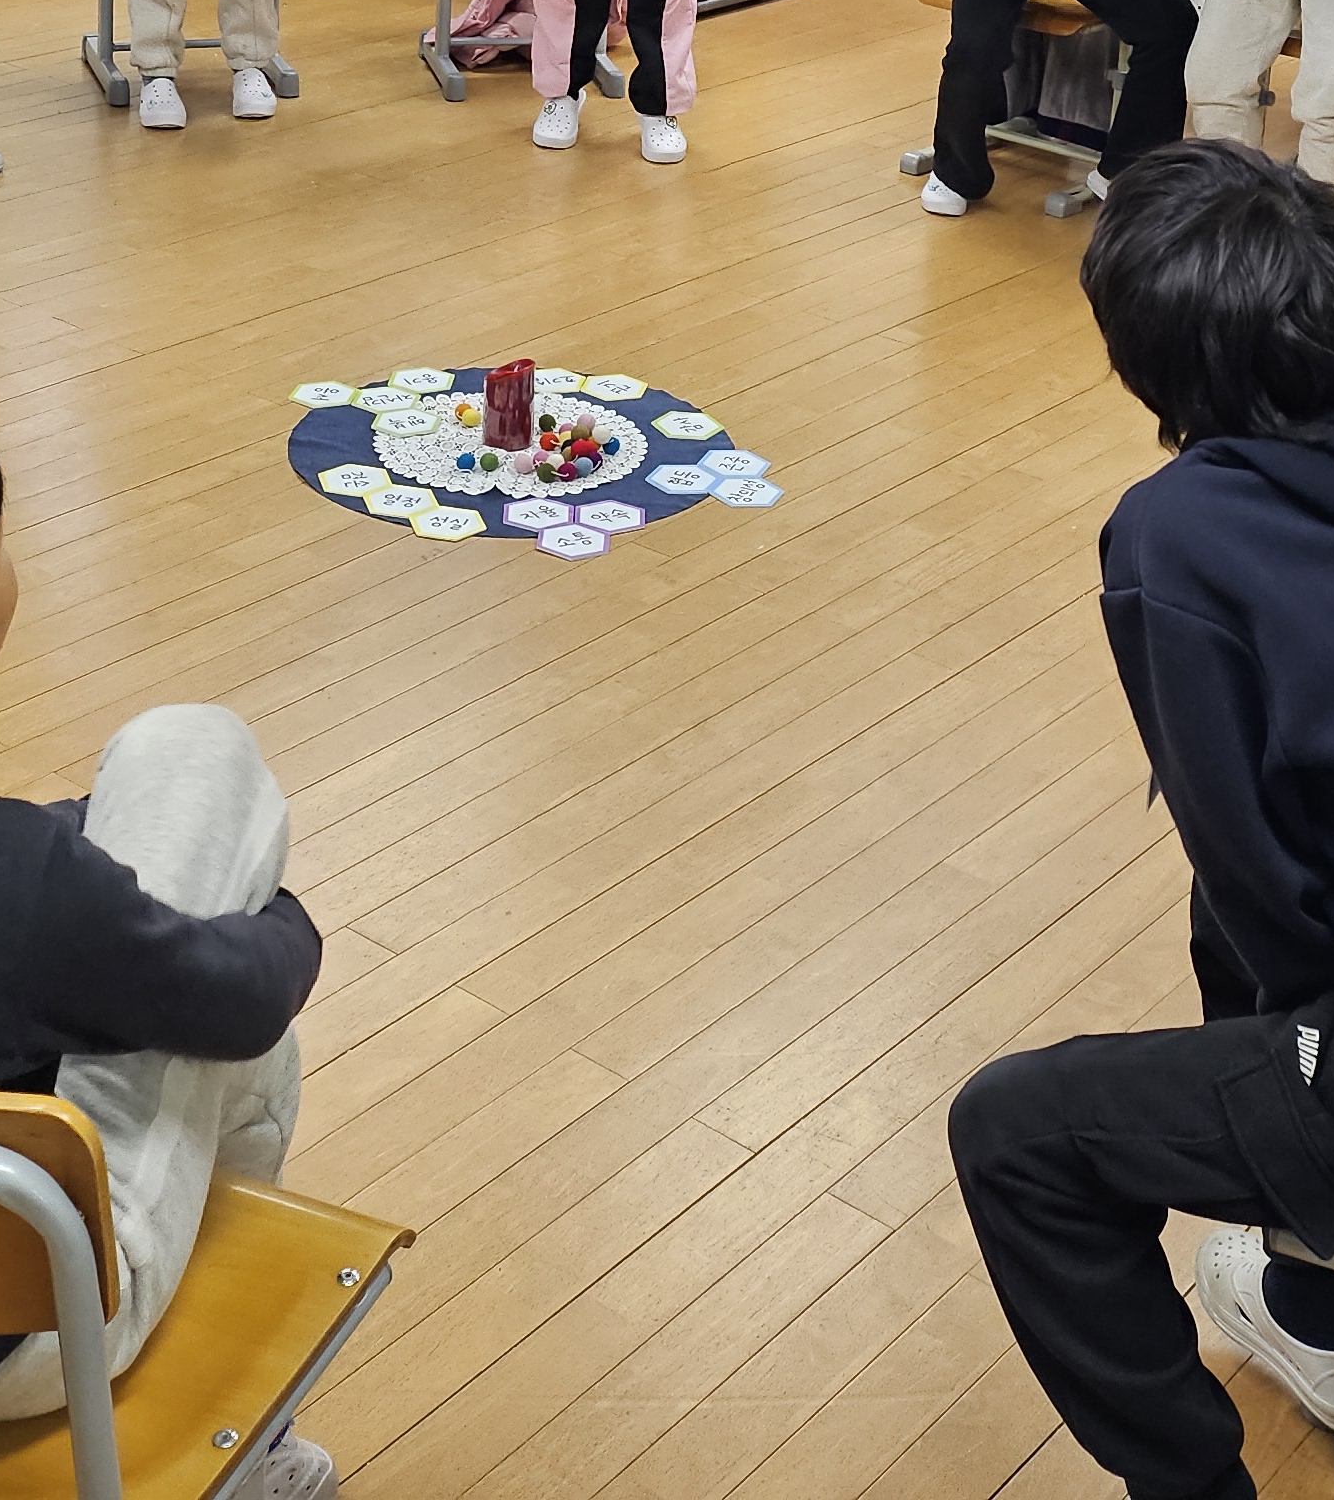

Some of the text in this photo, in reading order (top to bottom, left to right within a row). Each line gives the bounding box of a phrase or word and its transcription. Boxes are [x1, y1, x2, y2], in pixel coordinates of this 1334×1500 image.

[362, 393, 413, 407] 자신감
[590, 508, 631, 523] 약속
[430, 516, 469, 531] 성실
